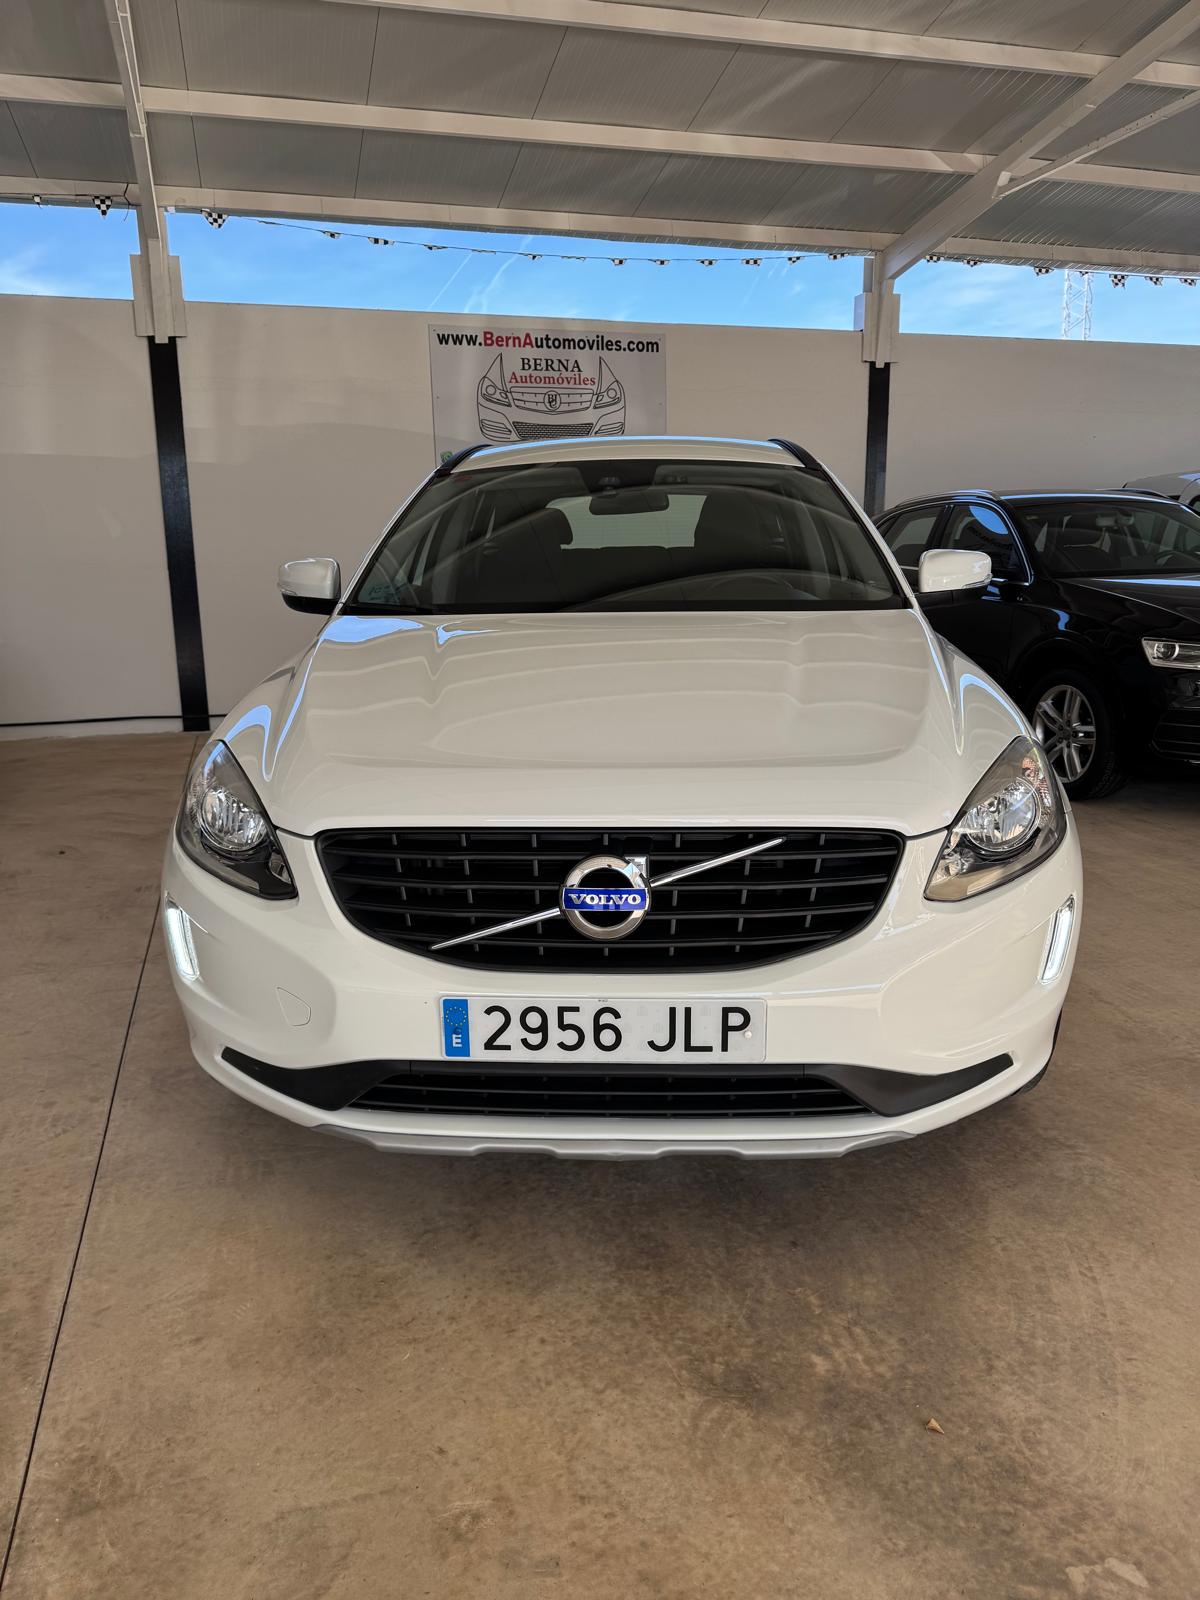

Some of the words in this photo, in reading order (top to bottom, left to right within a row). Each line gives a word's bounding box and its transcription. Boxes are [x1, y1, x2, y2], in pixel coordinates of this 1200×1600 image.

[437, 331, 659, 353] www.BernAutomoviles.com
[520, 357, 583, 373] BERNA
[508, 371, 596, 386] Automóviles
[568, 893, 642, 905] VOLVO
[483, 1005, 623, 1052] 2956
[647, 1006, 751, 1052] JLP
[452, 1034, 463, 1048] E
